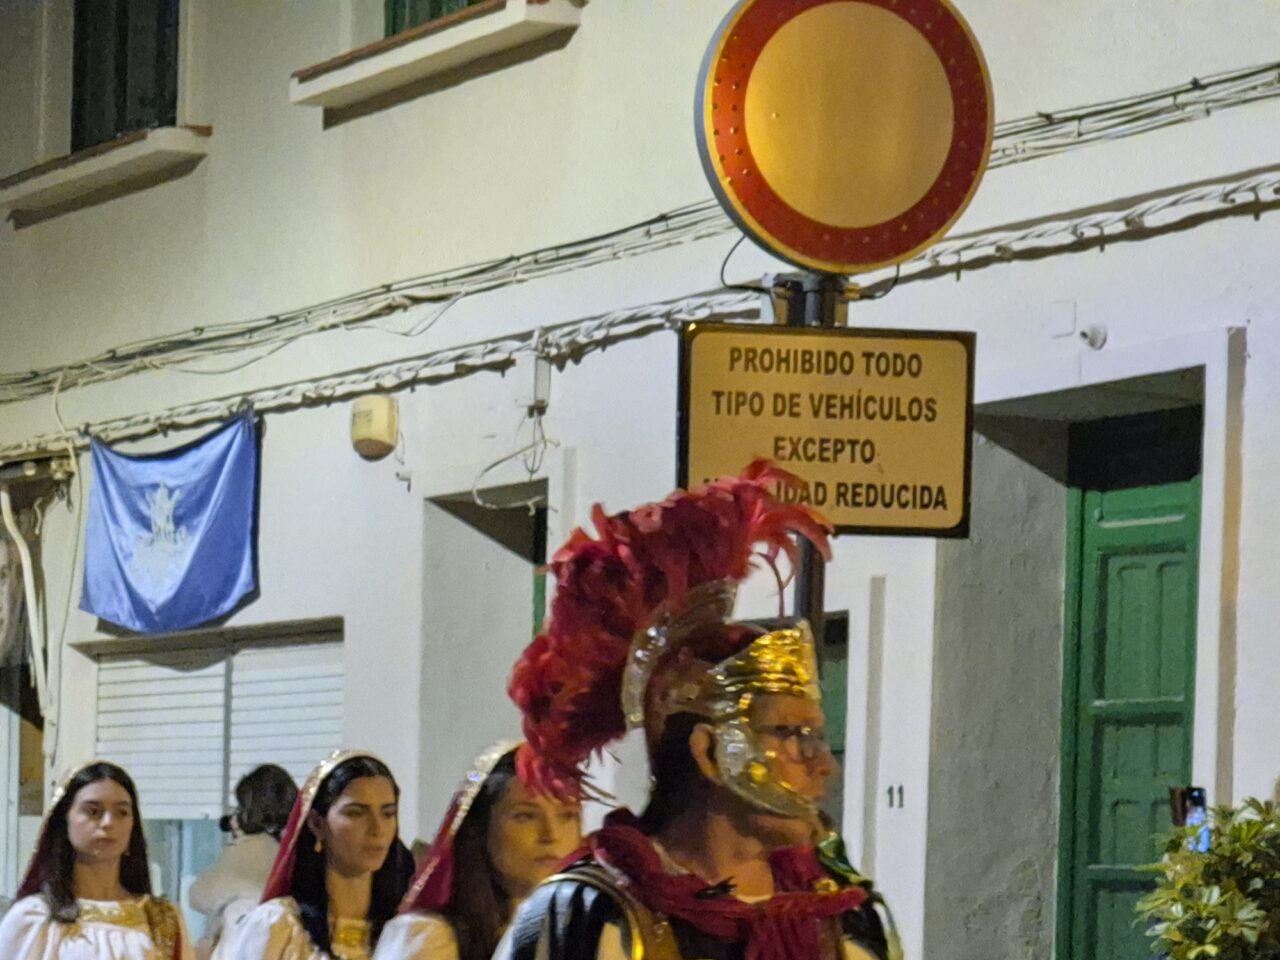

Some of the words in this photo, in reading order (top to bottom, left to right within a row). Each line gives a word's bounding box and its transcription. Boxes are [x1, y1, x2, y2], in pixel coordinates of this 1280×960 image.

[728, 347, 854, 376] PROHIBIDO
[862, 351, 923, 378] TODO
[712, 390, 765, 417] TIPO
[773, 393, 801, 418] DE
[809, 389, 938, 422] VEHÍCULOS
[773, 436, 876, 464] EXCEPTO
[835, 482, 947, 511] REDUCIDA
[887, 784, 904, 808] 11
